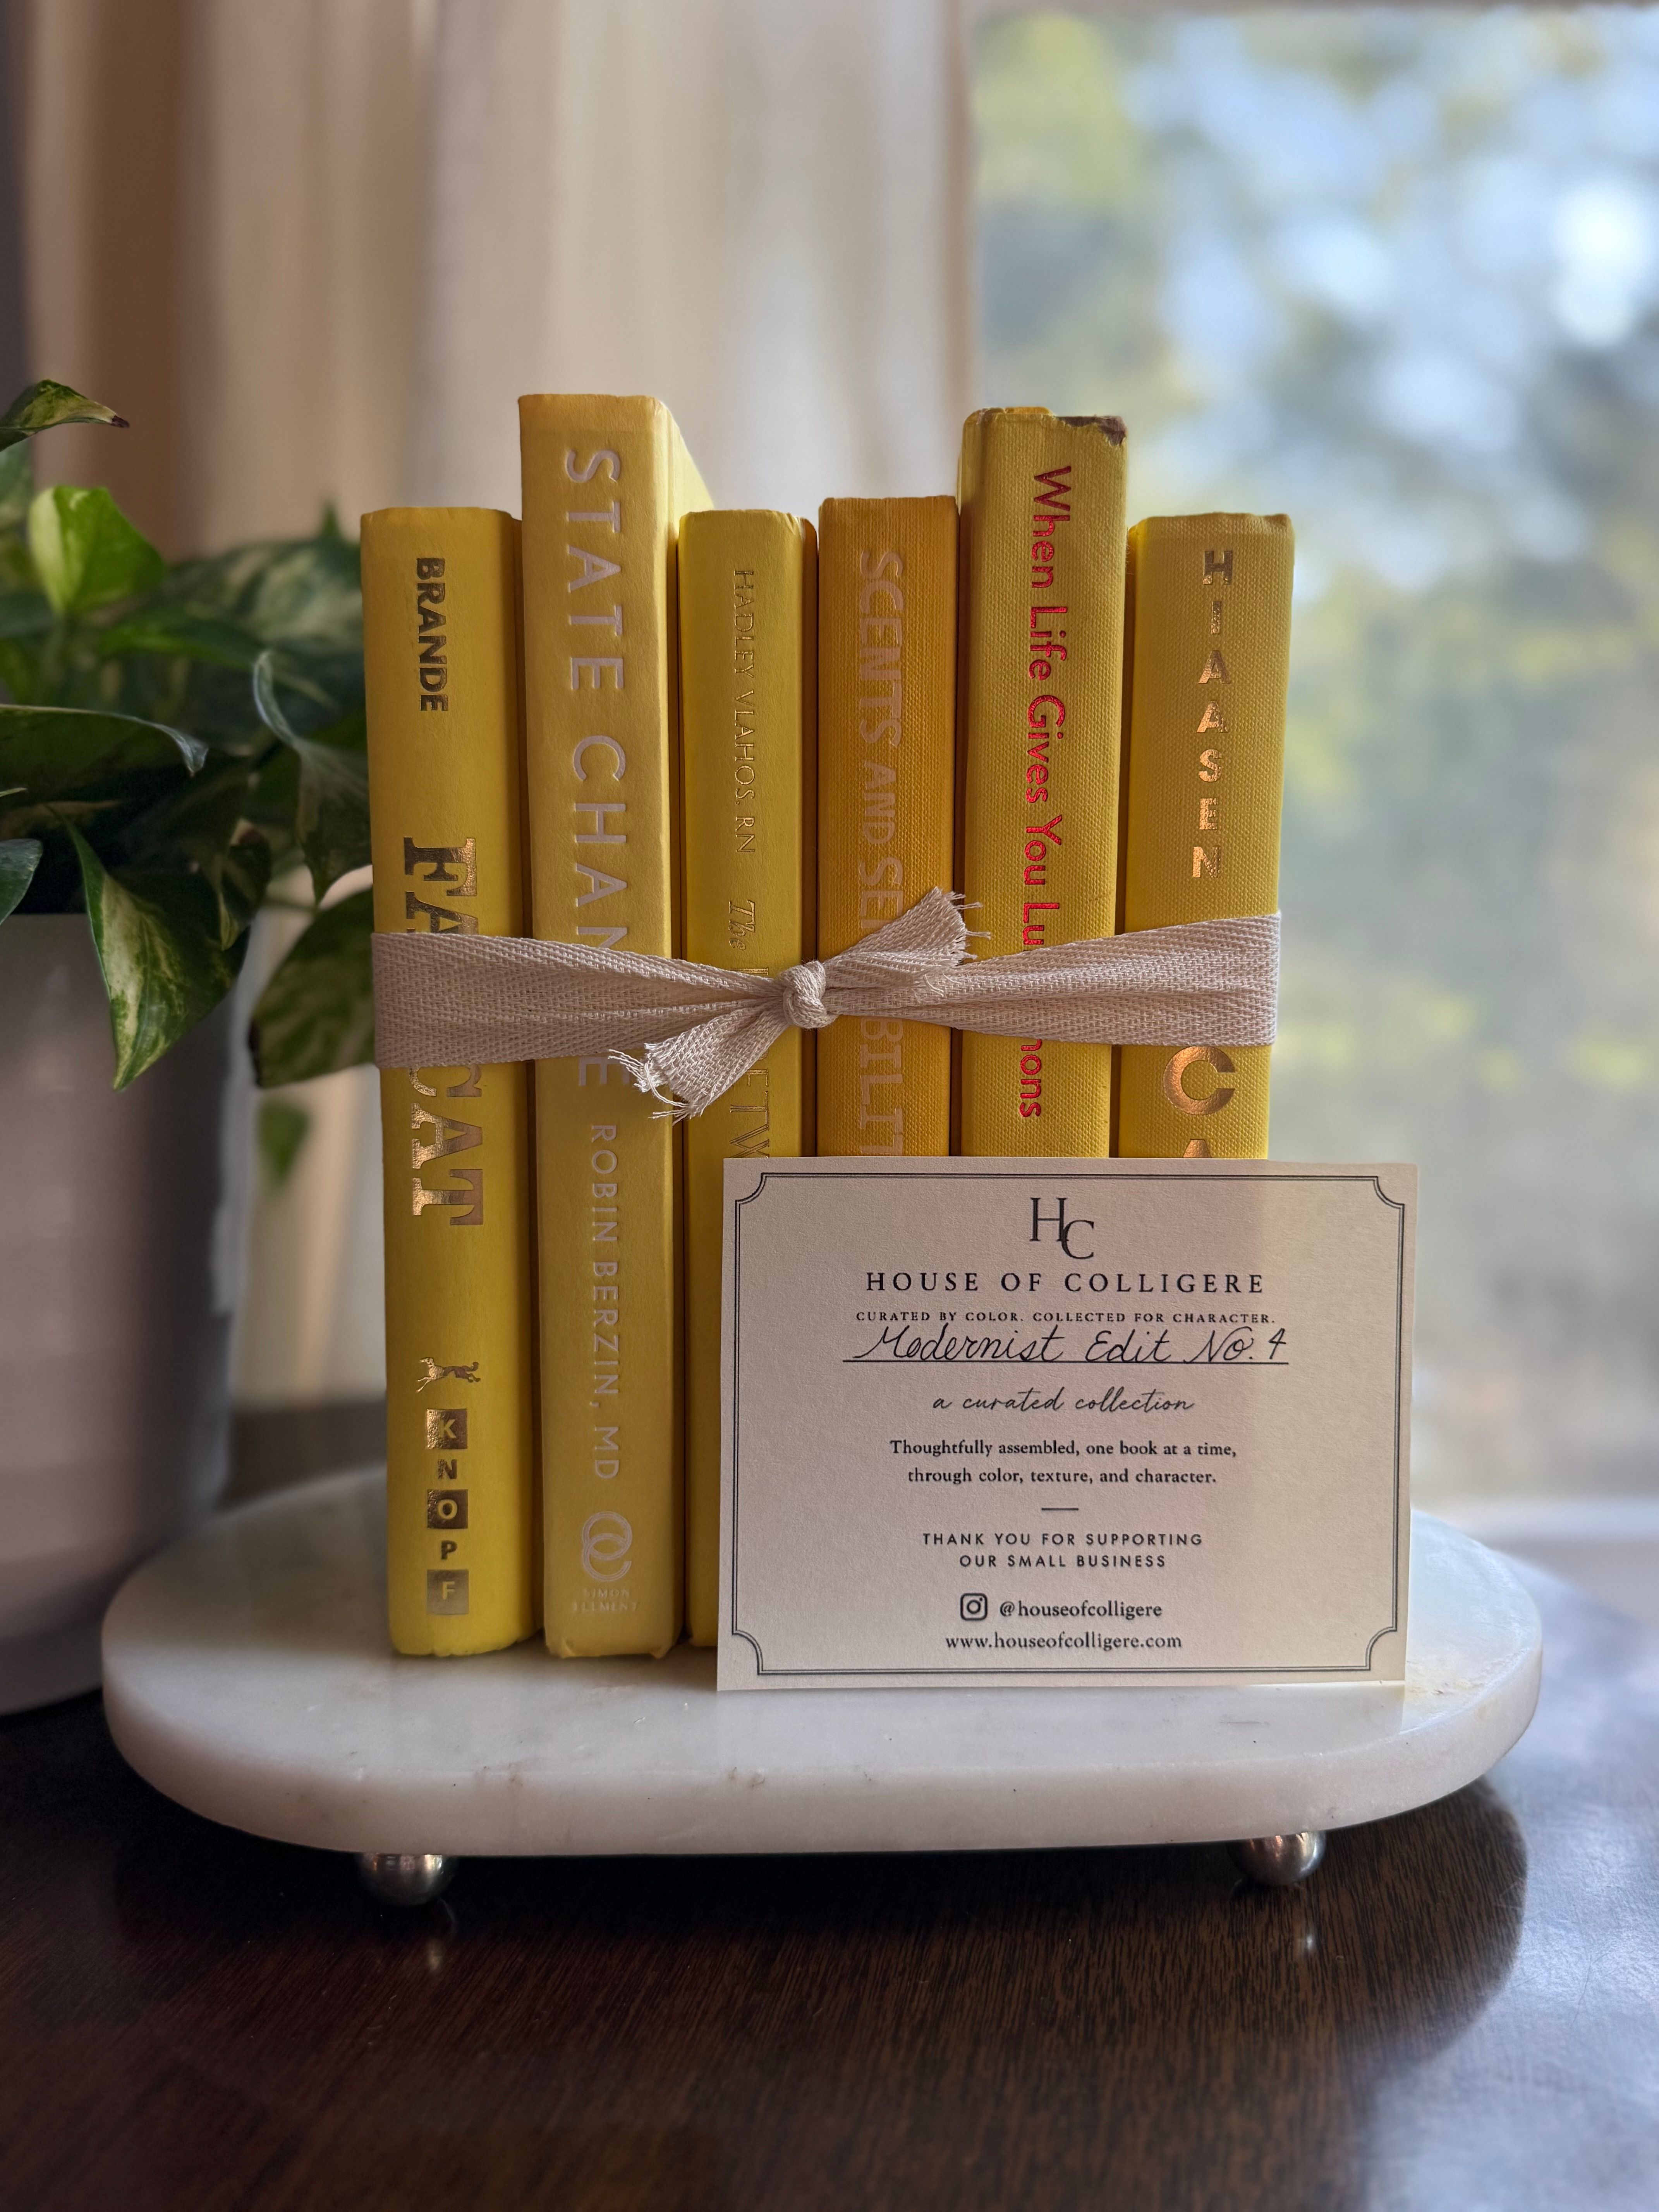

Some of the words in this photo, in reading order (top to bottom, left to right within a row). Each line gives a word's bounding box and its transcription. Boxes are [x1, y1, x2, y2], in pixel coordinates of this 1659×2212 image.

[1031, 465, 1072, 589] When
[565, 448, 623, 691] STATE
[416, 557, 449, 712] BRANDE
[734, 570, 754, 678] HADLEY
[859, 550, 903, 748] SCENTS
[1027, 606, 1068, 681] Life
[1192, 550, 1233, 879] HIAASEN
[1025, 694, 1066, 804] Gives
[863, 760, 896, 845] AND
[735, 817, 755, 853] RN
[1023, 815, 1063, 886] You
[728, 900, 756, 951] The
[591, 1124, 618, 1241] ROBIN
[866, 1272, 979, 1292] HOUSE
[1000, 1272, 1042, 1292] OF
[1064, 1272, 1264, 1294] COLLIGERE
[589, 1261, 620, 1408] BERZIN,
[853, 1322, 1066, 1362] Modernist
[1085, 1329, 1172, 1363] Edit
[1268, 1328, 1287, 1360] 4
[855, 1311, 931, 1321] CURATED
[939, 1311, 957, 1321] BY
[965, 1311, 1024, 1322] COLOR.
[1032, 1312, 1126, 1322] COLLECTED
[1134, 1312, 1164, 1323] FOR
[1172, 1313, 1275, 1324] CHARACTER.
[933, 1396, 955, 1410] a
[962, 1386, 1066, 1413] curated
[1074, 1386, 1196, 1414] collection
[594, 1426, 620, 1479] MD
[890, 1439, 993, 1458] Thoughtfully
[998, 1439, 1080, 1457] assembled,
[1085, 1444, 1115, 1455] one
[1119, 1440, 1158, 1455] book
[1163, 1444, 1178, 1455] at
[1183, 1445, 1192, 1455] a
[1197, 1442, 1237, 1458] time,
[908, 1467, 972, 1486] through
[978, 1467, 1024, 1484] color,
[1030, 1470, 1094, 1484] texture,
[1099, 1467, 1129, 1483] and
[1135, 1468, 1217, 1484] character.
[922, 1532, 985, 1546] THANK
[994, 1532, 1031, 1546] YOU
[1041, 1533, 1075, 1546] FOR
[1085, 1533, 1203, 1547] SUPPORTING
[959, 1554, 997, 1568] OUR
[1007, 1554, 1066, 1568] SMALL
[1076, 1554, 1166, 1569] BUSINESS
[999, 1599, 1163, 1621] @houseofcolligere
[945, 1630, 1183, 1652] www.houseofcolligere.com
